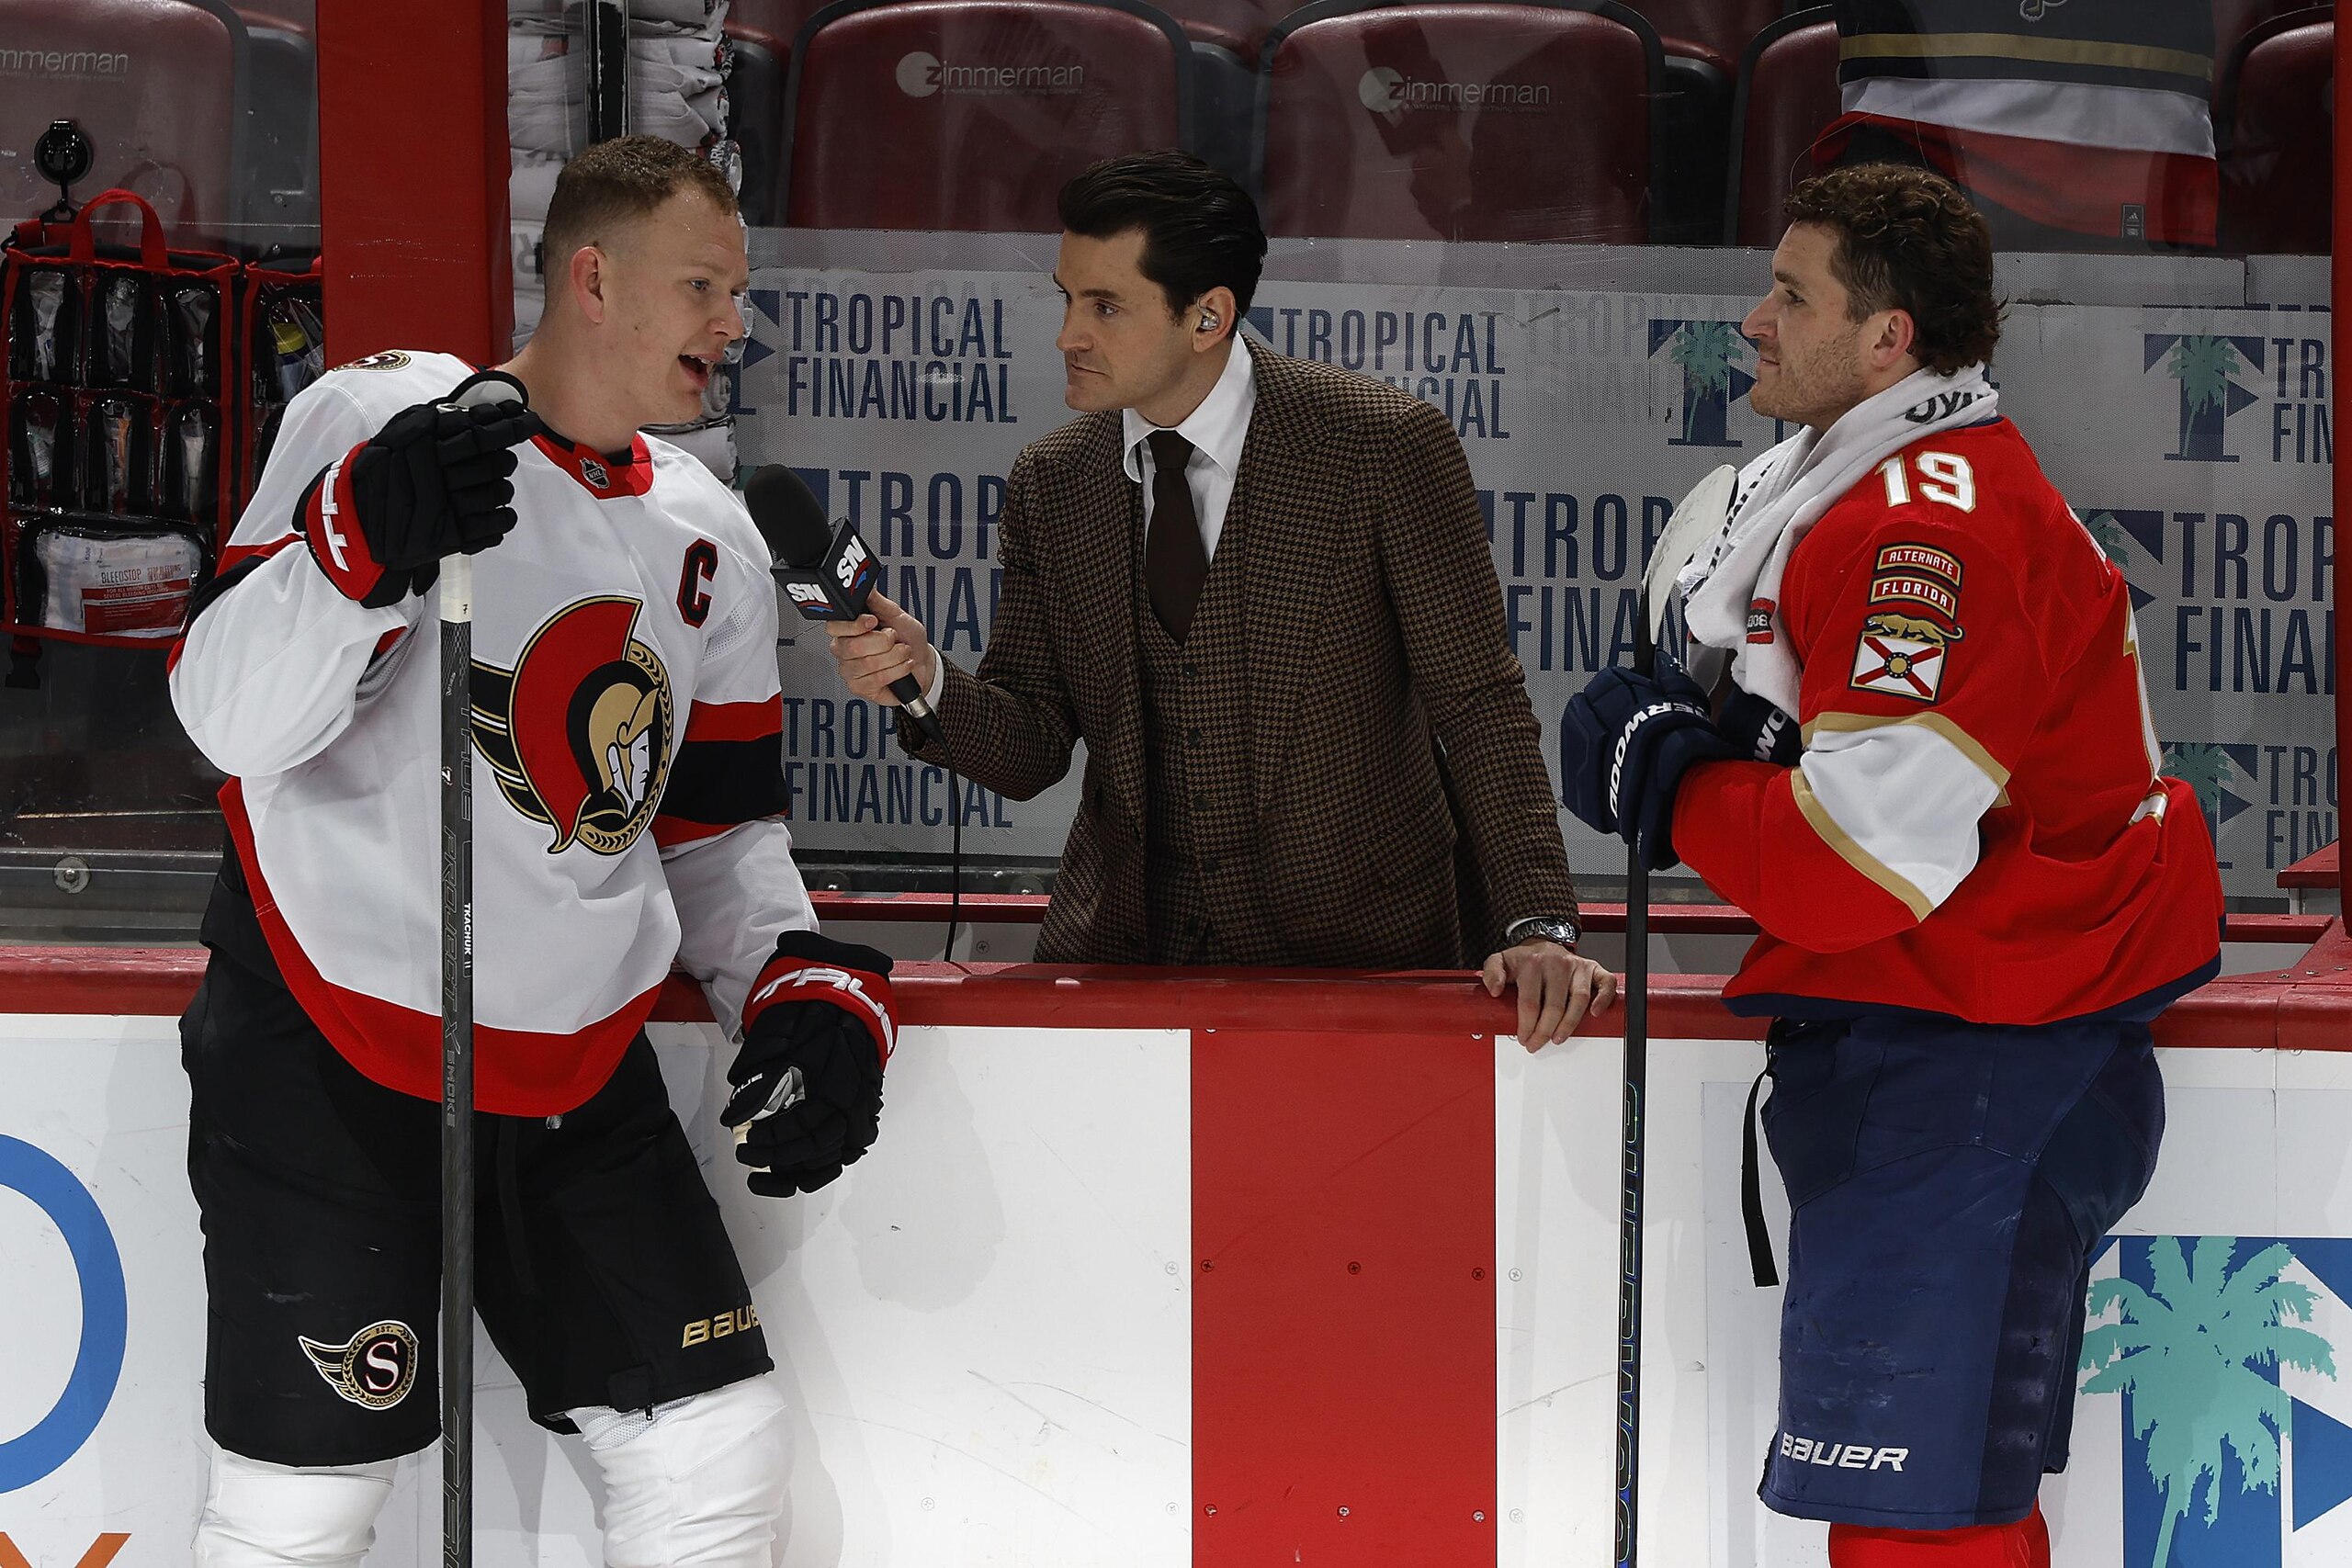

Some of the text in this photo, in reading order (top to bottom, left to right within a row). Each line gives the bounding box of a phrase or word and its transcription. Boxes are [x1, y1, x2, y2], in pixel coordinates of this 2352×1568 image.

[925, 60, 1084, 87] zimmerman
[1388, 75, 1551, 105] zimmerman
[786, 291, 1012, 358] TROPICAL
[1280, 309, 1506, 375] TROPICAL
[788, 357, 1018, 423] FINANCIAL
[1875, 450, 1976, 513] 19
[676, 538, 718, 628] C
[836, 536, 867, 589] SN
[1888, 549, 1954, 576] ALTERNATE
[786, 581, 830, 605] SN
[1881, 580, 1949, 607] FLORIDA
[784, 761, 1013, 828] FINANCIAL
[463, 903, 472, 956] TKACHUK
[366, 1339, 400, 1391] S
